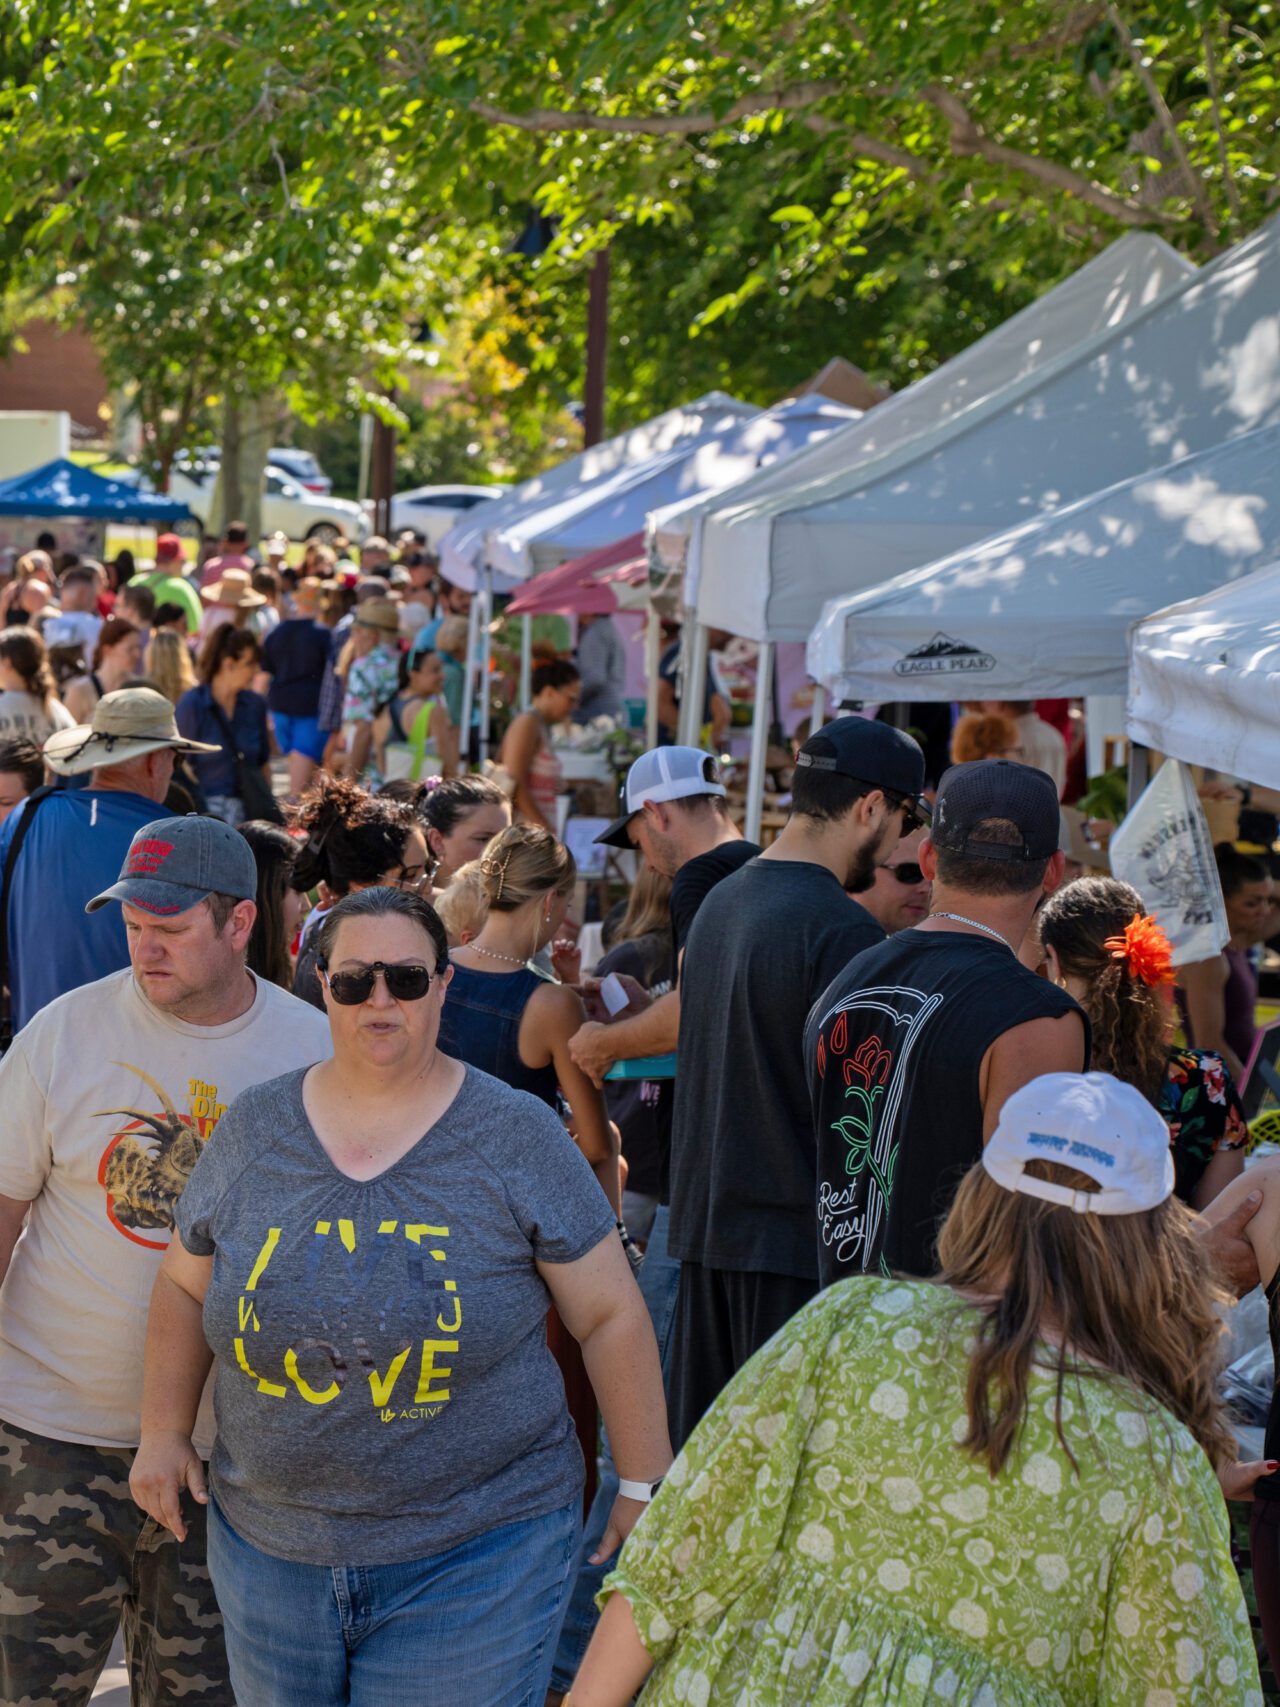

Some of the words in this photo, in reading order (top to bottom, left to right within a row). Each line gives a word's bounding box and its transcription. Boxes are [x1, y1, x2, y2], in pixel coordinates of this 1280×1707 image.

[900, 659, 946, 673] EAGLE
[950, 657, 989, 669] PEAK
[188, 1078, 218, 1099] The
[818, 1177, 859, 1220] Rest
[822, 1213, 866, 1262] Easy
[233, 1337, 459, 1408] LOVE
